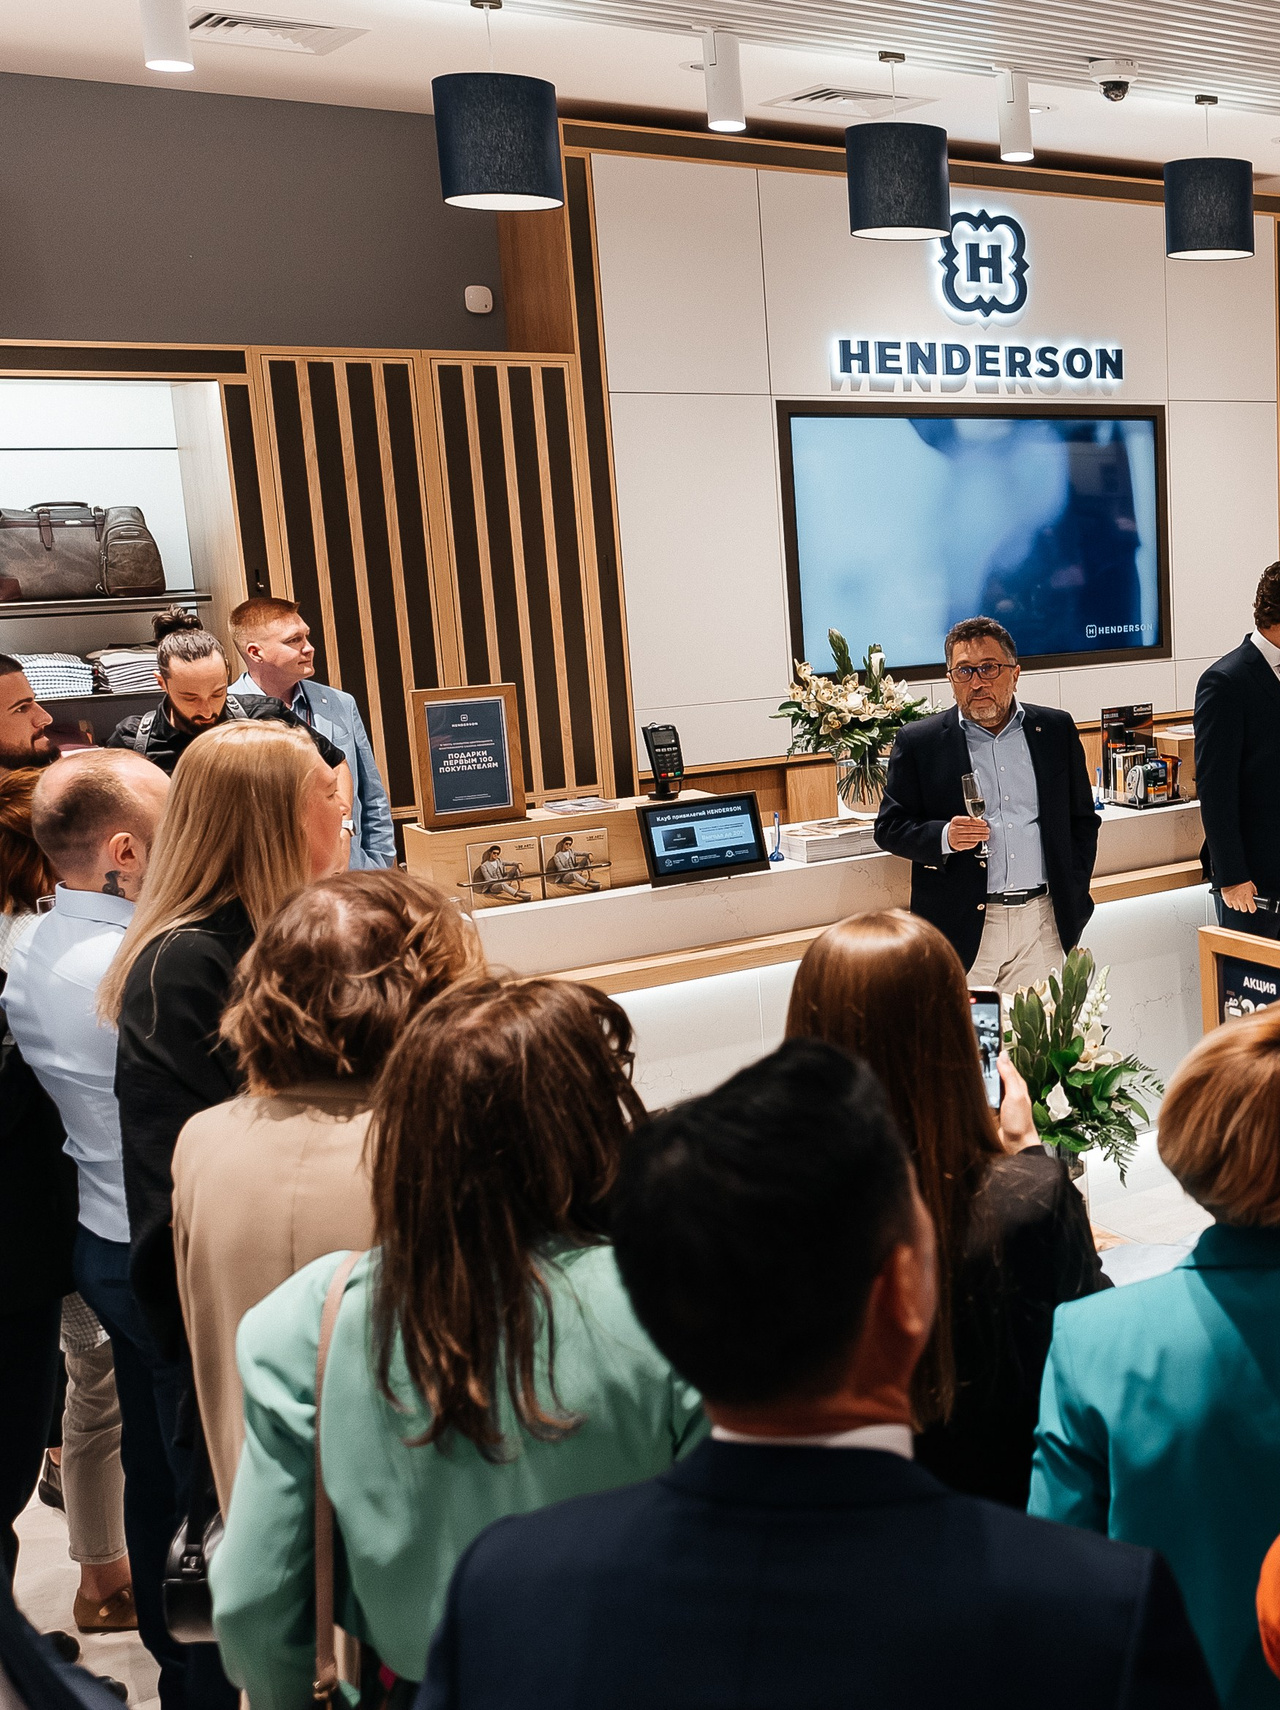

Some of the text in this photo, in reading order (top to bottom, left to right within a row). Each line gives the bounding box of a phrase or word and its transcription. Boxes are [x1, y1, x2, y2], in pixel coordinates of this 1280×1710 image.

[966, 243, 1003, 284] H
[838, 340, 1123, 380] HENDERSON
[1098, 623, 1153, 635] HENDERSON
[448, 750, 488, 759] ПОДАРКИ
[438, 762, 499, 773] ПОКУПАТЕЛЯМ
[443, 758, 477, 766] ПЕРВЫМ
[706, 805, 742, 815] HENDERSON
[1243, 976, 1277, 995] АКЦИЯ
